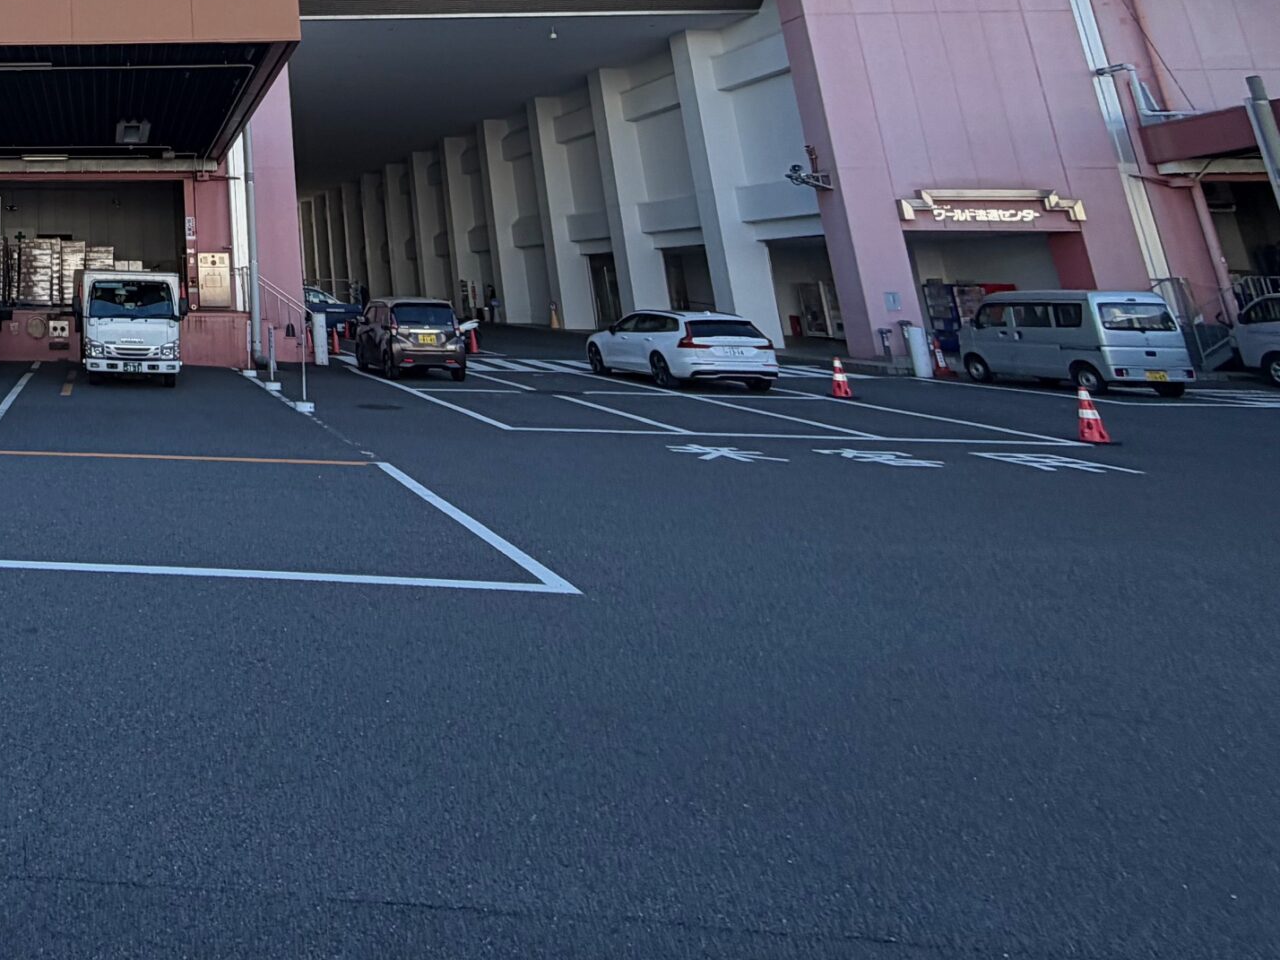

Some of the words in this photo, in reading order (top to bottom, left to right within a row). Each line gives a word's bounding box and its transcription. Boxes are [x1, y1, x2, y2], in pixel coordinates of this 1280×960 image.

[933, 208, 1040, 221] ワールド流通センター
